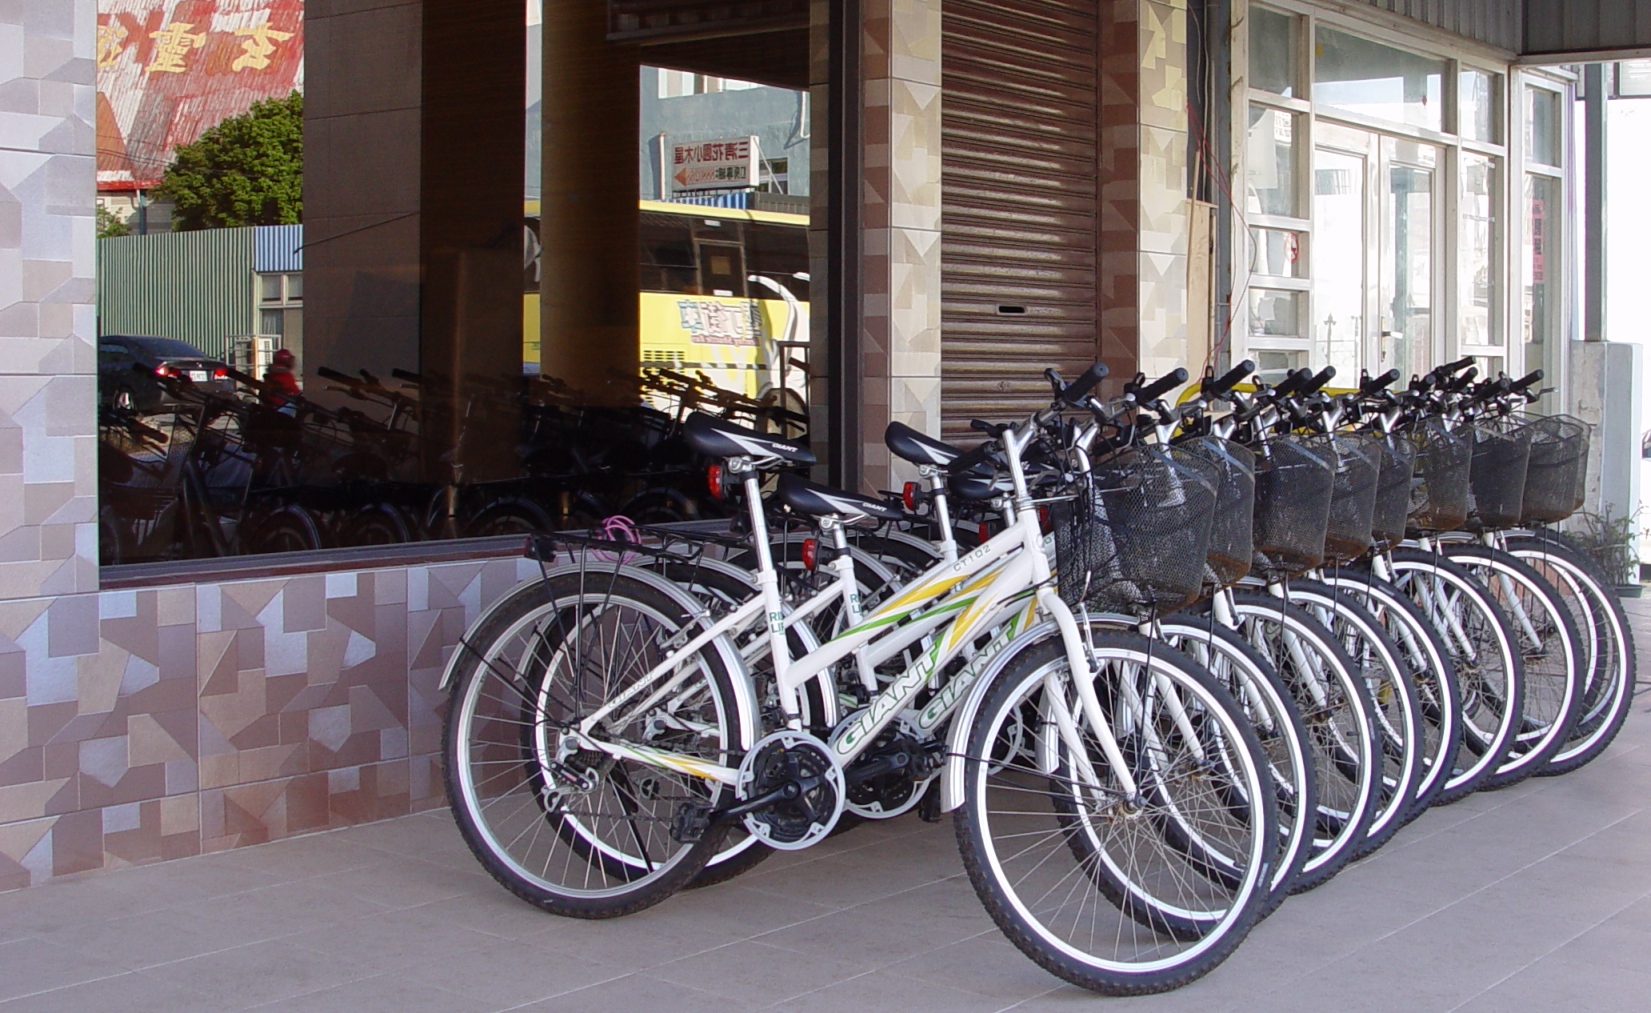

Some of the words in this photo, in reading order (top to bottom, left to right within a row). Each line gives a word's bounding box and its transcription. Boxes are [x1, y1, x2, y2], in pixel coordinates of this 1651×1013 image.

[771, 442, 799, 453] GIANT
[861, 501, 888, 512] GIANT
[953, 544, 991, 572] CT102
[836, 638, 941, 755] GIANT
